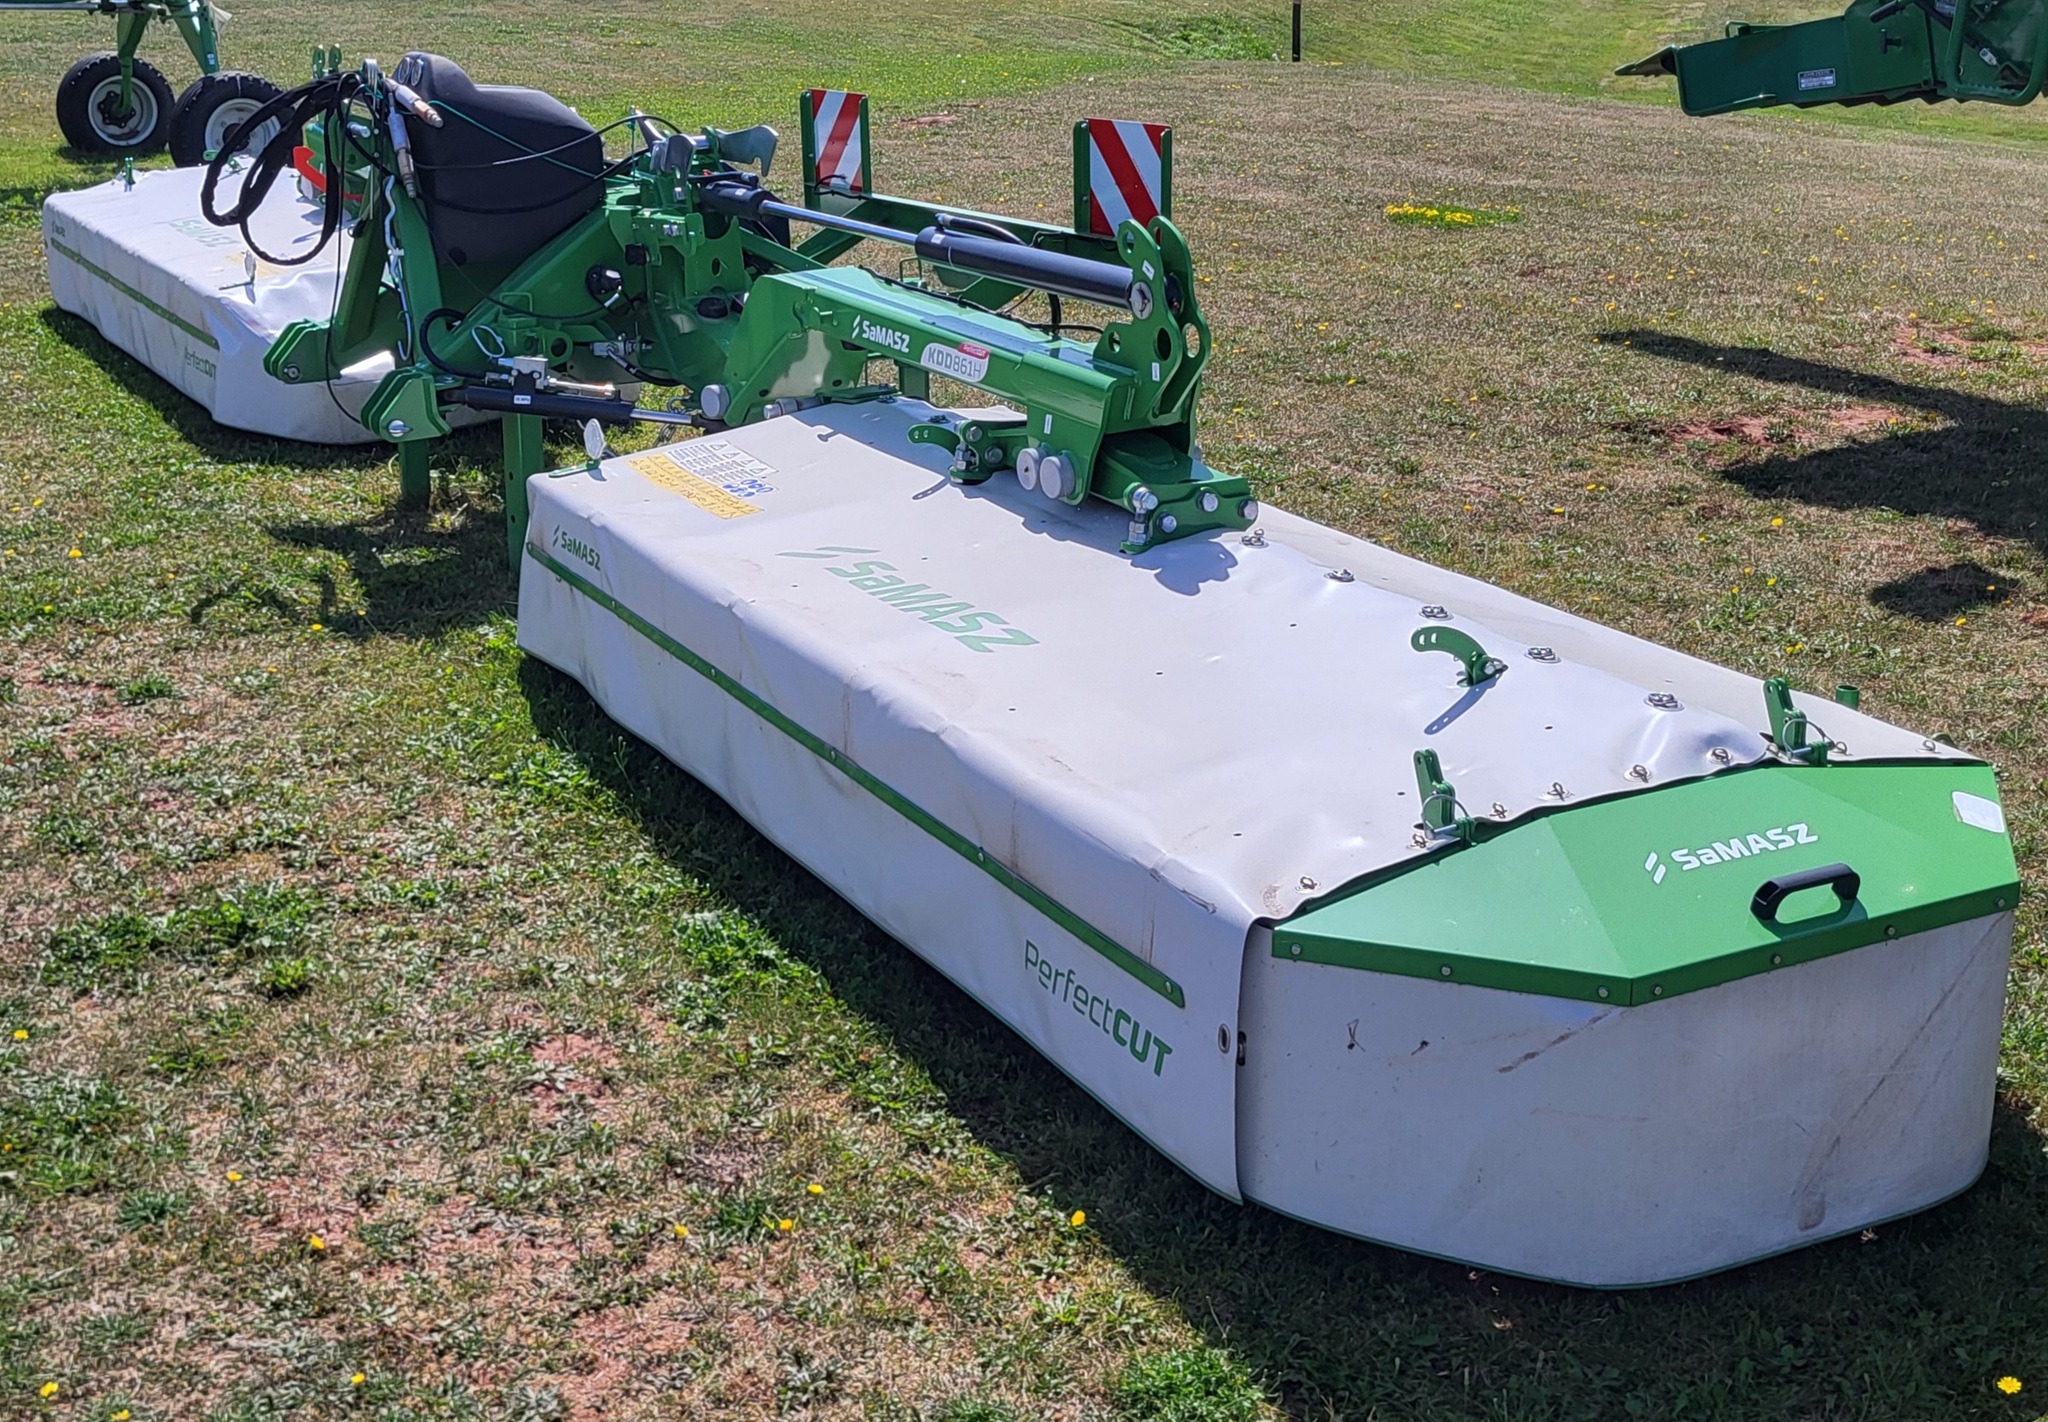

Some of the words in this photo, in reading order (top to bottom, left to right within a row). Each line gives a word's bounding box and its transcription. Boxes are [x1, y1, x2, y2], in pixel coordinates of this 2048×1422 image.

[862, 320, 910, 353] SaMASZ
[927, 346, 981, 379] KDD861H
[561, 530, 601, 571] SaMASZ
[824, 561, 1040, 652] SaMASZ
[1671, 822, 1819, 872] SaMASZ
[1024, 939, 1173, 1077] PerfectCUT
